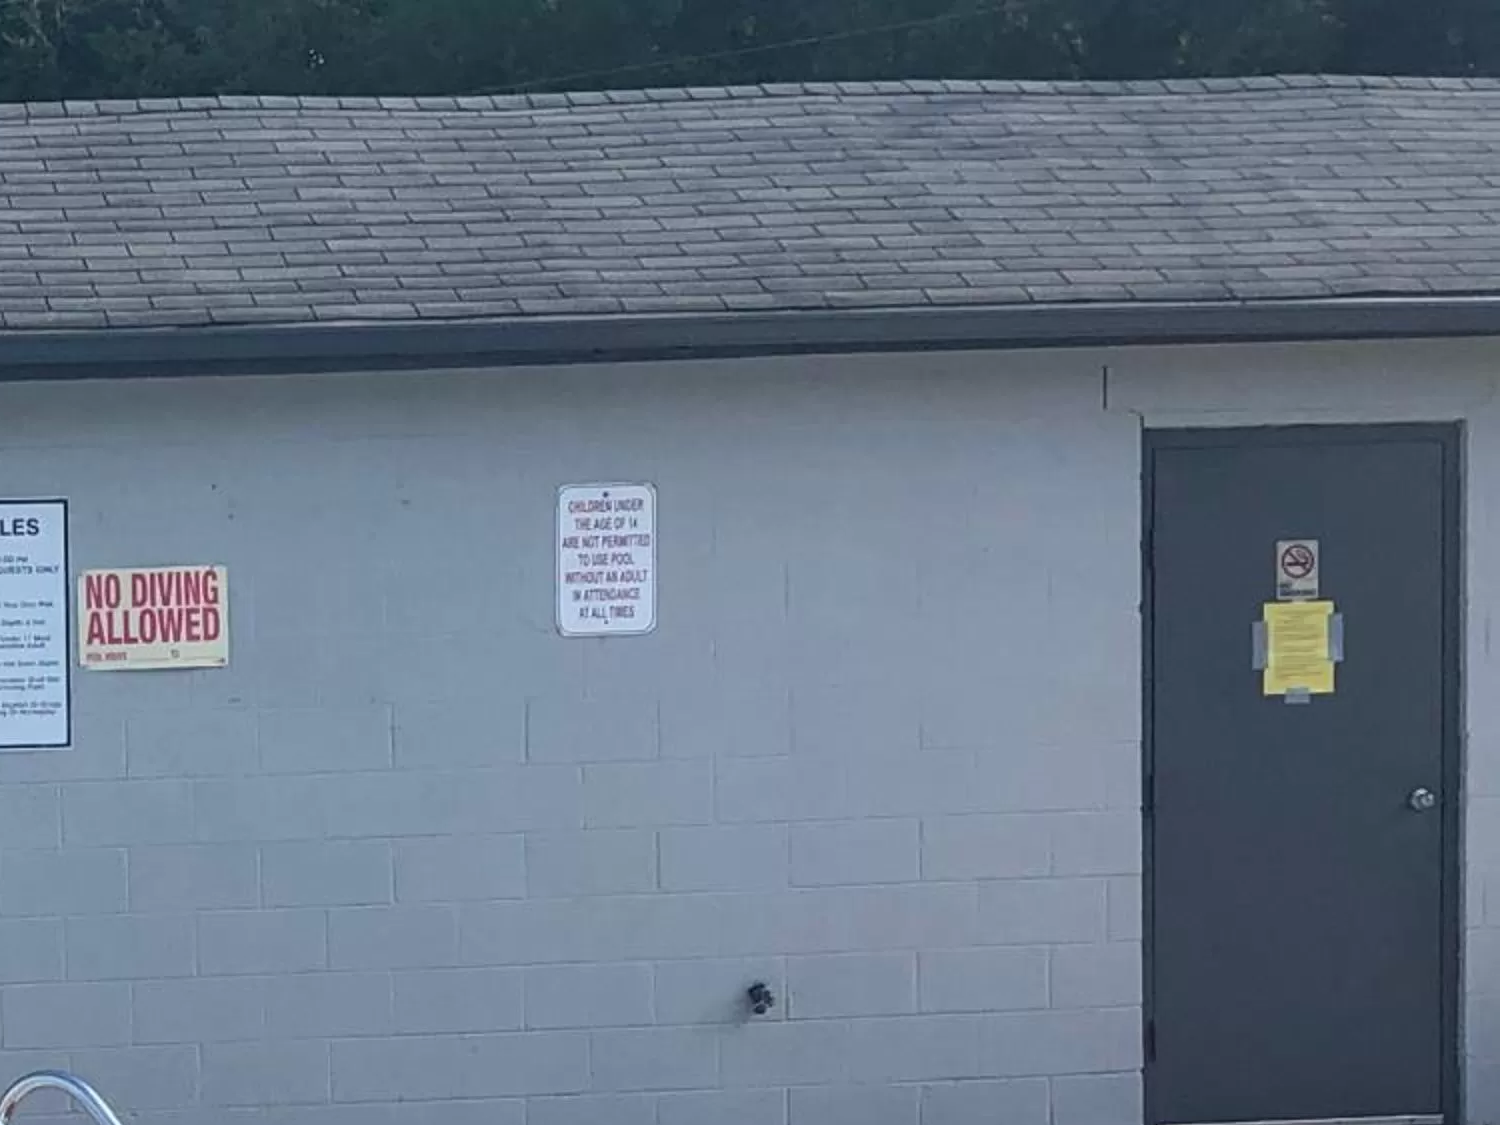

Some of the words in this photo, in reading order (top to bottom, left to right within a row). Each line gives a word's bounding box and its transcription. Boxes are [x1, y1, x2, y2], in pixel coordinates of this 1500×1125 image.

[568, 500, 612, 513] CHILDREN
[614, 498, 644, 512] UNDER
[574, 518, 591, 530] THE
[562, 536, 579, 549] ARE
[582, 536, 599, 549] NOT
[602, 534, 650, 548] PERMITTED
[578, 553, 590, 566] TO
[611, 552, 634, 565] POOL
[620, 570, 647, 583] ADULT
[86, 573, 121, 610] NO
[132, 570, 219, 607] DIVING
[591, 607, 607, 619] ALL
[87, 607, 220, 645] ALLOWED
